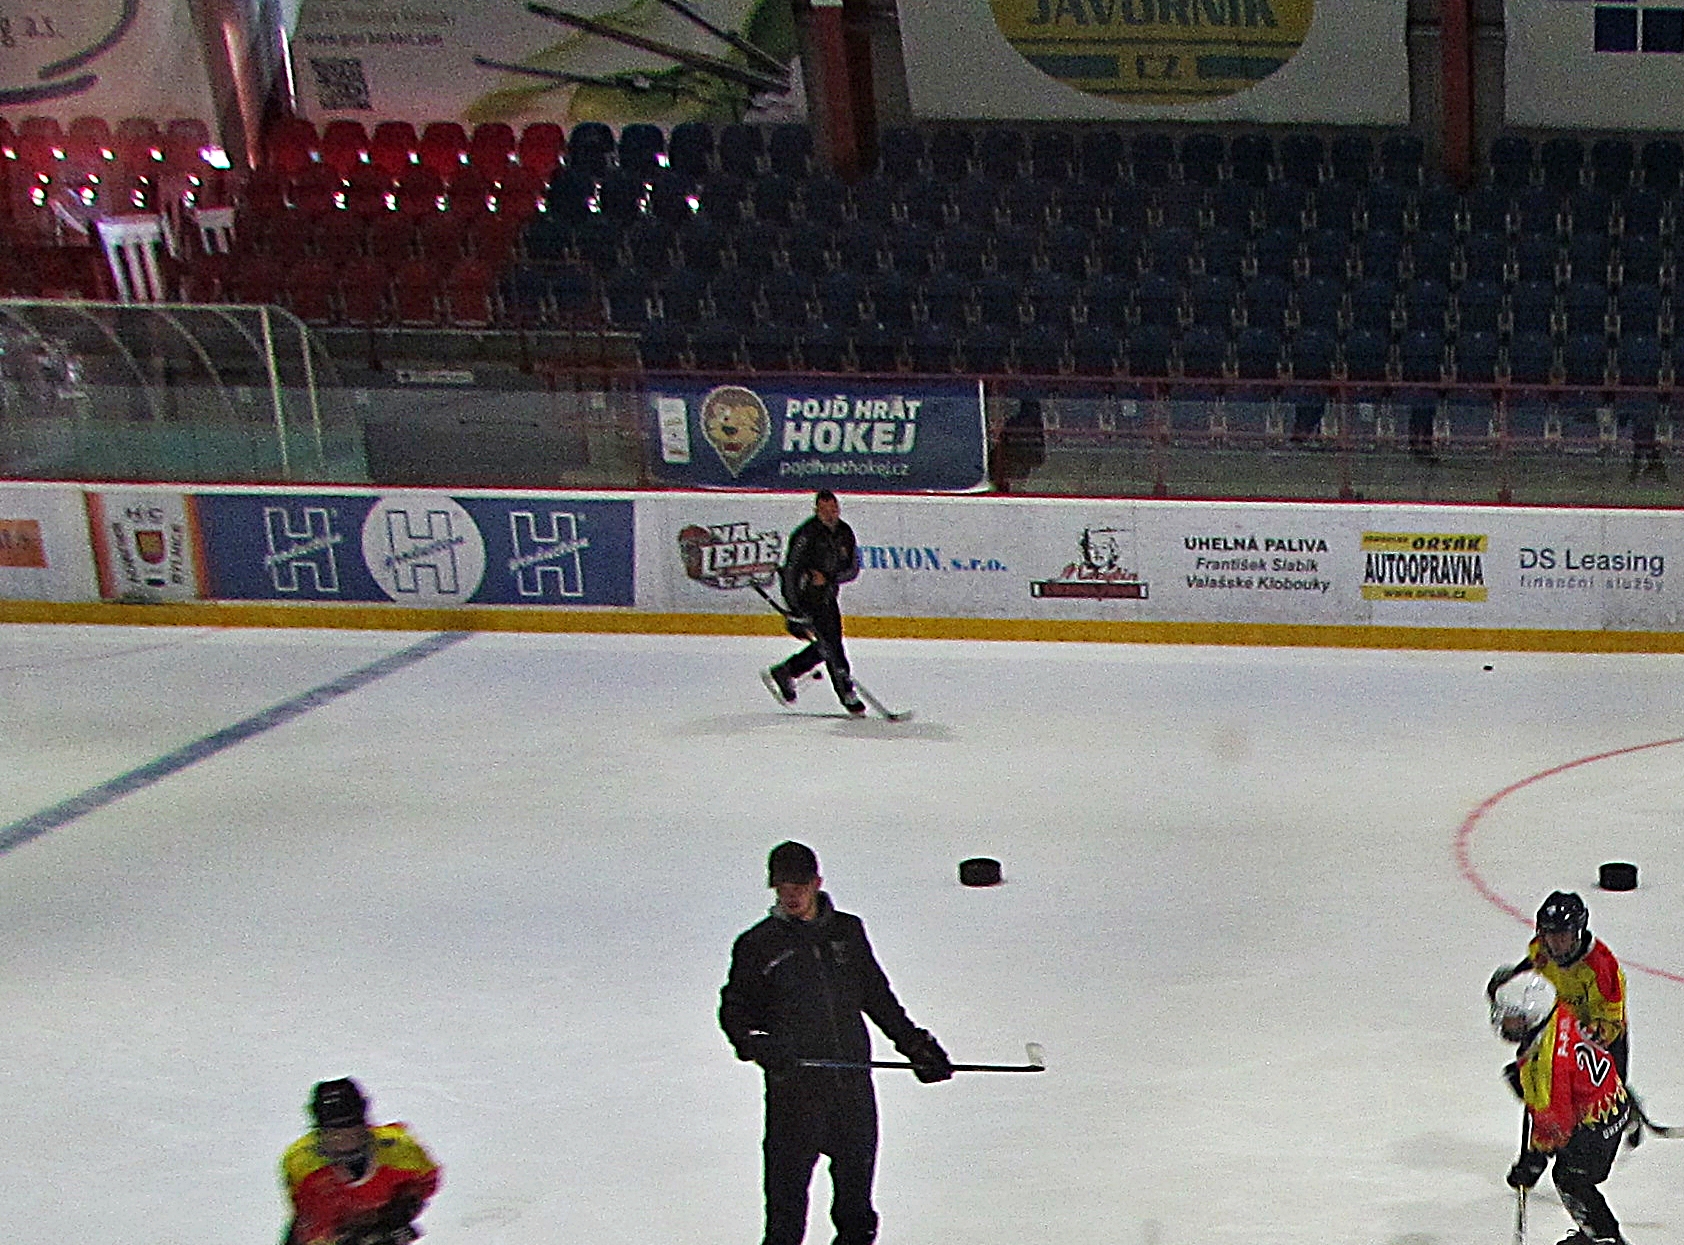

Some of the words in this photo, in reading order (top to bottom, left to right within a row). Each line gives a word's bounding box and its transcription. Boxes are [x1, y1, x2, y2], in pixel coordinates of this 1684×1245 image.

[786, 394, 850, 420] POJĎ
[853, 395, 923, 421] HRÁT
[782, 420, 919, 454] HOKEJ
[1184, 535, 1259, 552] UHELNÁ
[1264, 538, 1329, 553] PALIVA
[950, 558, 1008, 572] s.r.o.
[1195, 557, 1267, 571] František
[1364, 553, 1484, 585] AUTOOPRAVNA
[1519, 547, 1557, 570] DS
[1565, 548, 1665, 578] Leasing
[1186, 574, 1254, 589] Valašské
[1257, 576, 1331, 594] Klobouky
